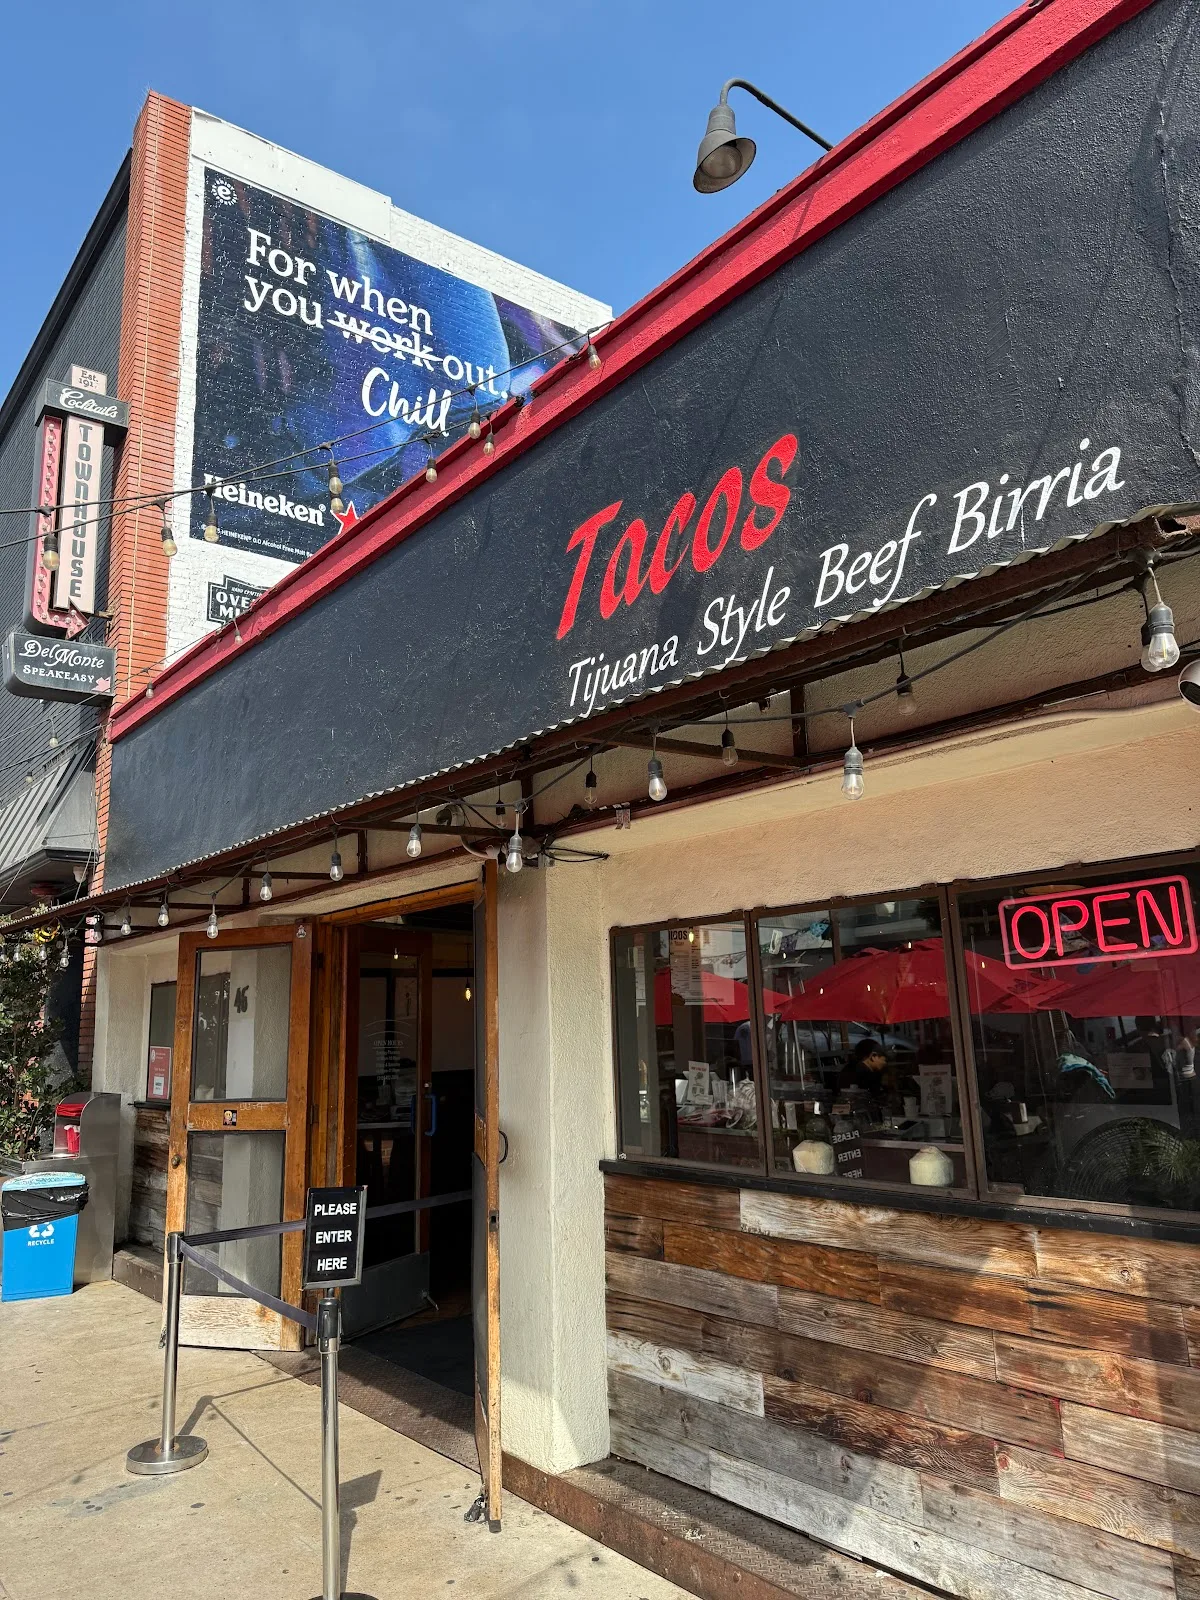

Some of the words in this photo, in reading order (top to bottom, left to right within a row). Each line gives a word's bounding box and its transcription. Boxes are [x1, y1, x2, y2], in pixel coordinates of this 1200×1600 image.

[246, 227, 317, 286] For
[326, 269, 433, 336] when
[244, 275, 324, 329] you
[332, 310, 436, 372] work
[442, 355, 508, 399] out.
[79, 377, 97, 388] 191
[80, 370, 99, 382] Est.
[60, 388, 119, 418] Cocktails
[361, 367, 452, 437] Chill
[69, 424, 93, 598] TOWNHOUSE
[262, 540, 282, 550] Alcohol
[556, 432, 798, 640] Tacos
[567, 634, 679, 716] Tijuana
[697, 565, 791, 660] Style
[813, 494, 937, 606] Beef
[947, 437, 1127, 555] Birria
[216, 592, 251, 608] OVE
[19, 640, 60, 658] Del
[44, 649, 105, 668] Monte
[23, 665, 95, 683] SPEAKEASY
[1011, 886, 1184, 960] OPEN
[314, 1203, 357, 1216] PLEASE
[27, 1239, 55, 1247] RECYCLE
[315, 1230, 352, 1244] ENTER
[317, 1257, 347, 1271] HERE
